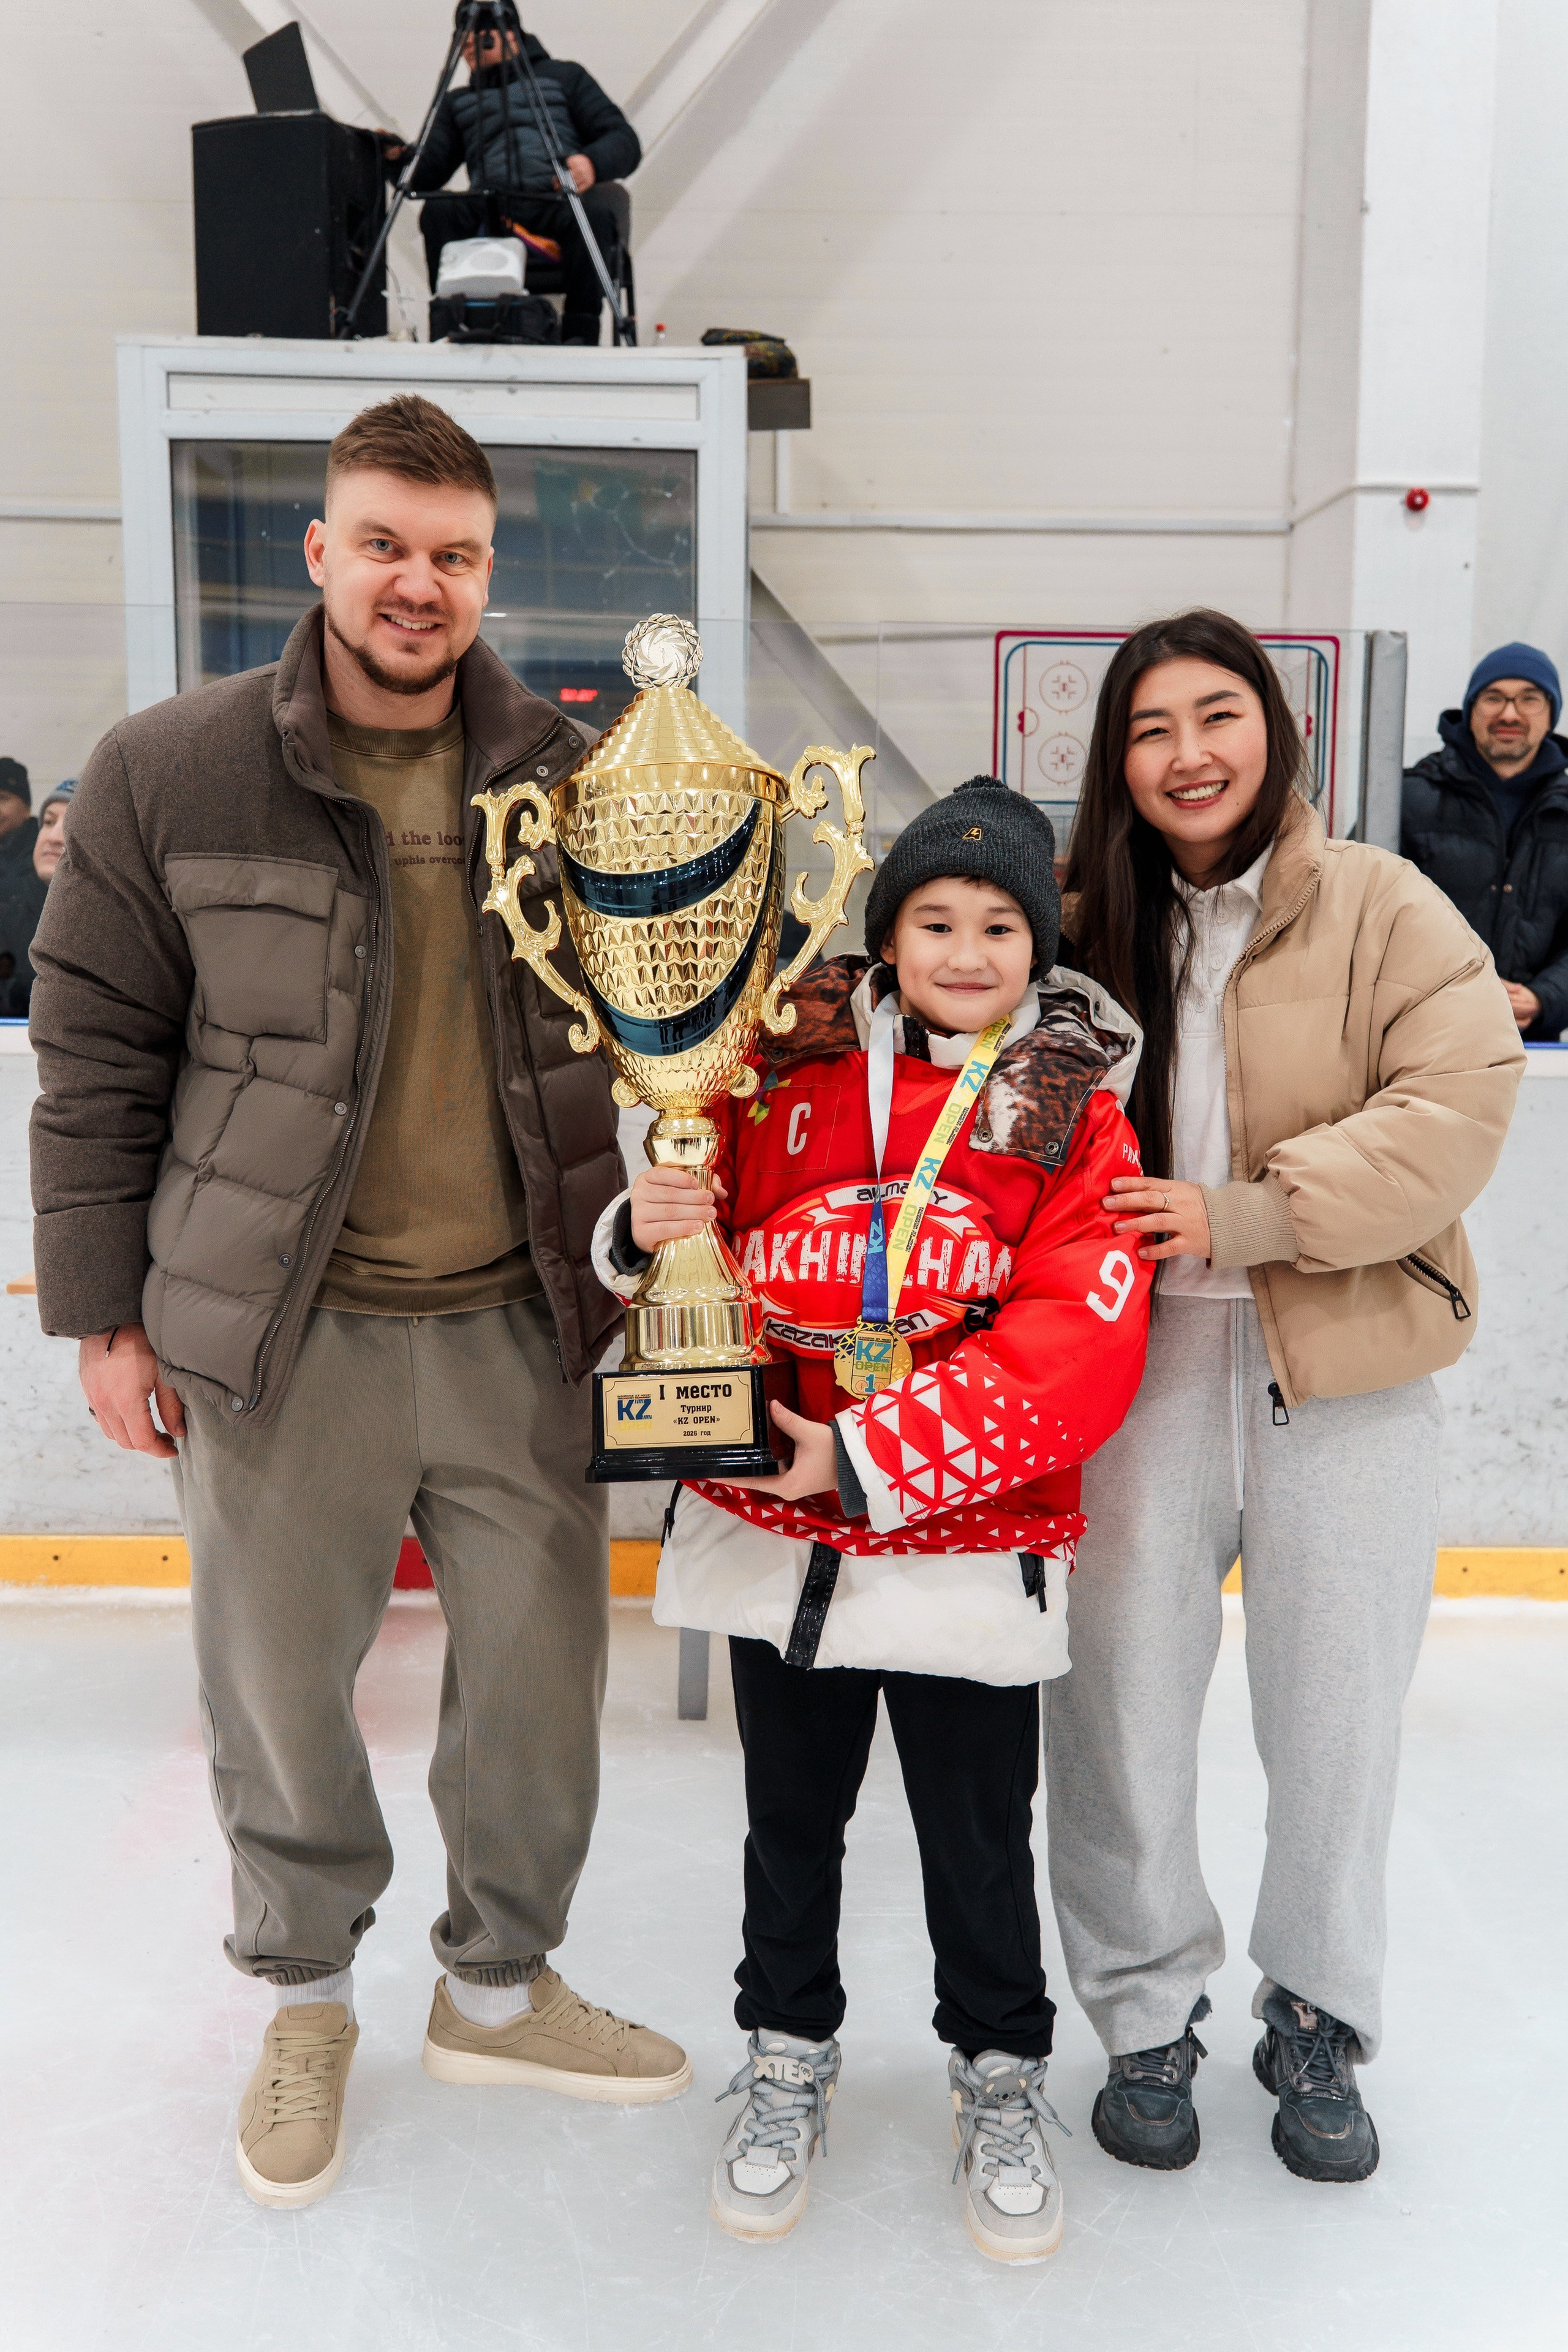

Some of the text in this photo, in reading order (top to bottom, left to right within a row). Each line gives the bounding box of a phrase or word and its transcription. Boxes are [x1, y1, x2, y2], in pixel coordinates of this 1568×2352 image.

[401, 831, 431, 845] the
[437, 831, 464, 846] loo
[960, 1060, 990, 1093] KZ
[787, 1102, 811, 1155] C
[933, 1102, 962, 1144] OPEN
[914, 1157, 941, 1189] KZ
[868, 1218, 883, 1254] KZ
[892, 1204, 918, 1251] OPEN
[1085, 1250, 1135, 1322] 9
[856, 1340, 892, 1363] KZ
[855, 1361, 890, 1372] OPEN
[864, 1374, 876, 1393] 1
[617, 1399, 652, 1420] KZ
[680, 1404, 712, 1414] Турнир
[693, 1415, 720, 1424] OPEN»
